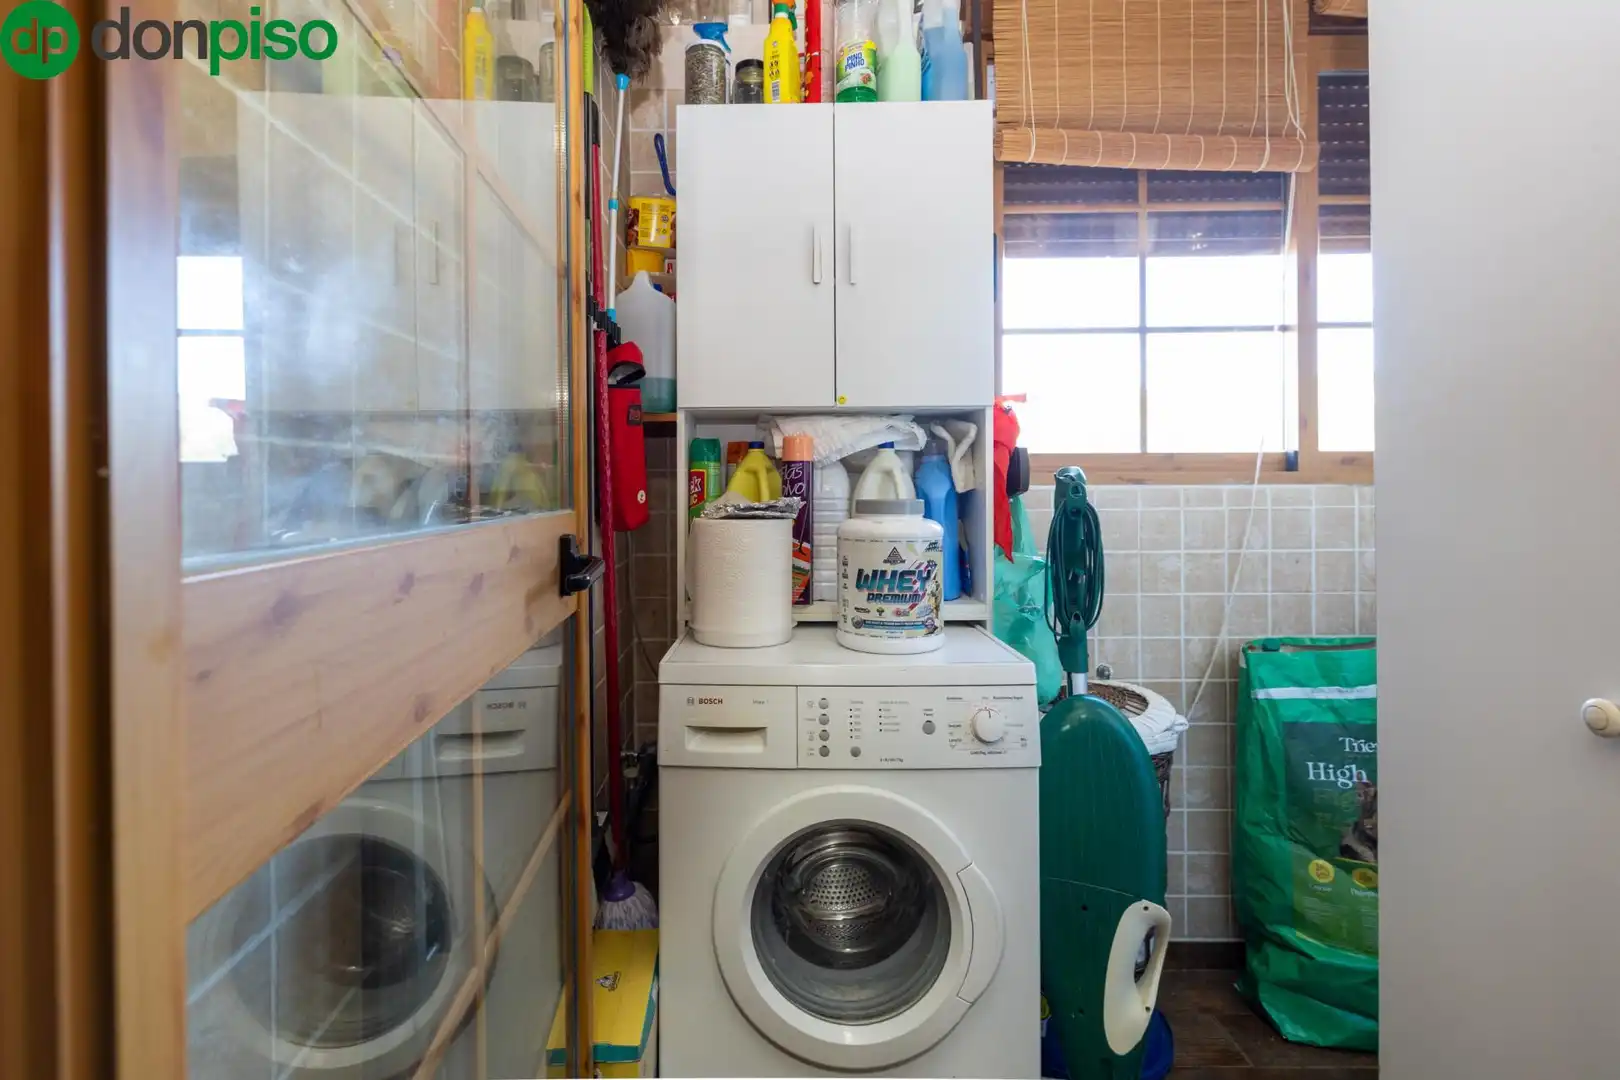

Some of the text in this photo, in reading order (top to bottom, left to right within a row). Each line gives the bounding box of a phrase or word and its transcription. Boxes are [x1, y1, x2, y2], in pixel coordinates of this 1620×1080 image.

[855, 568, 932, 593] WHEY
[866, 592, 923, 604] PREMIUM
[1338, 736, 1378, 753] Trie
[1305, 761, 1370, 789] High
